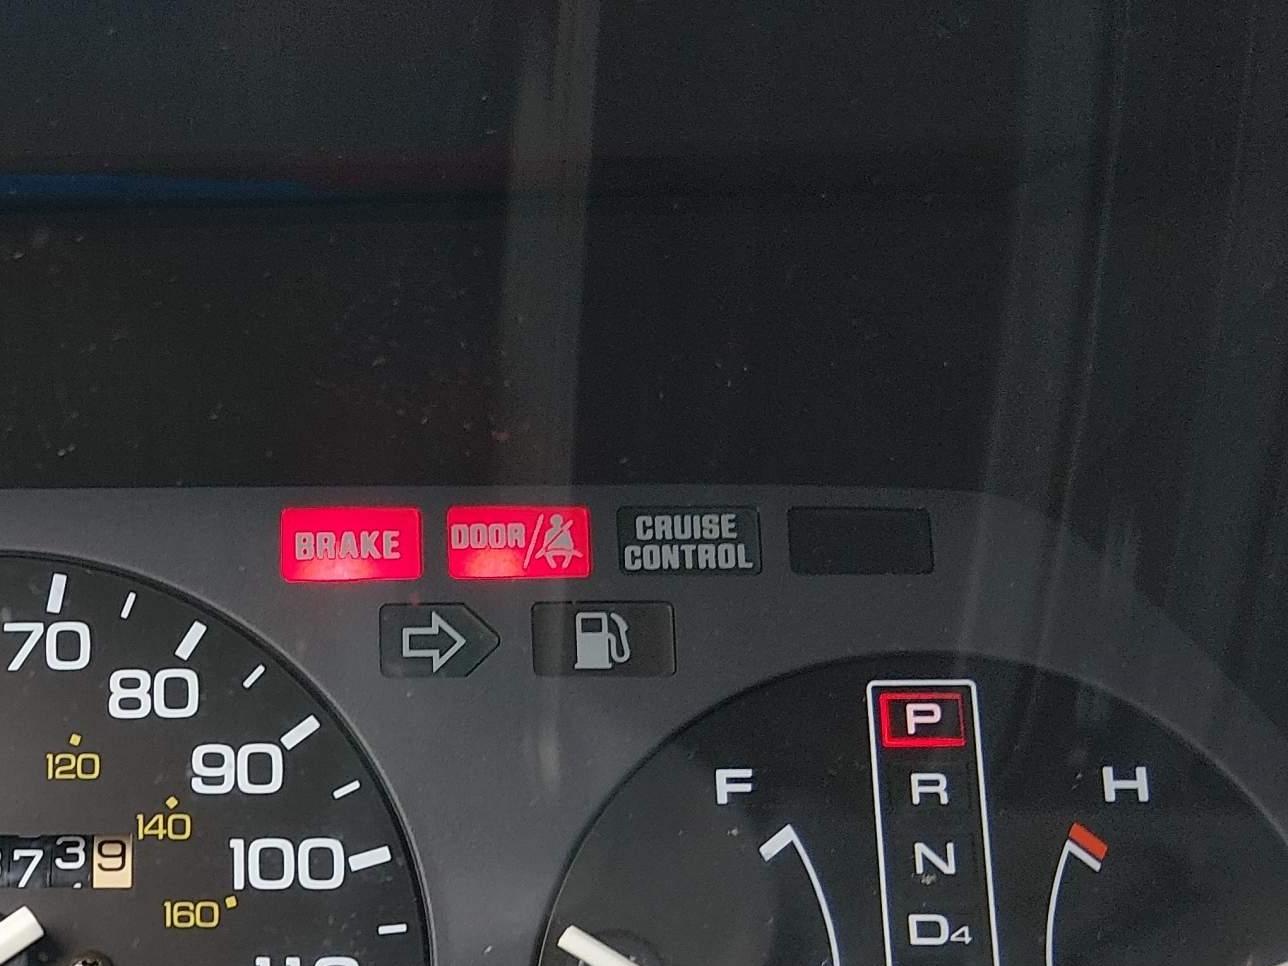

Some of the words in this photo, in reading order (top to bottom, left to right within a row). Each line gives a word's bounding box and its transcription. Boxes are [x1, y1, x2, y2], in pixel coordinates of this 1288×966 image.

[634, 513, 738, 541] CRUISE
[294, 530, 402, 561] BRAKE
[623, 542, 754, 571] CONTROL
[2, 620, 92, 672] 70
[107, 667, 200, 720] 80
[905, 702, 943, 736] P
[45, 752, 102, 780] 120
[189, 742, 285, 795] 90
[715, 768, 753, 804] F
[910, 772, 950, 805] R
[1101, 765, 1150, 802] H
[135, 813, 192, 841] 140
[229, 837, 345, 891] 100
[913, 842, 956, 875] N
[163, 901, 220, 929] 160
